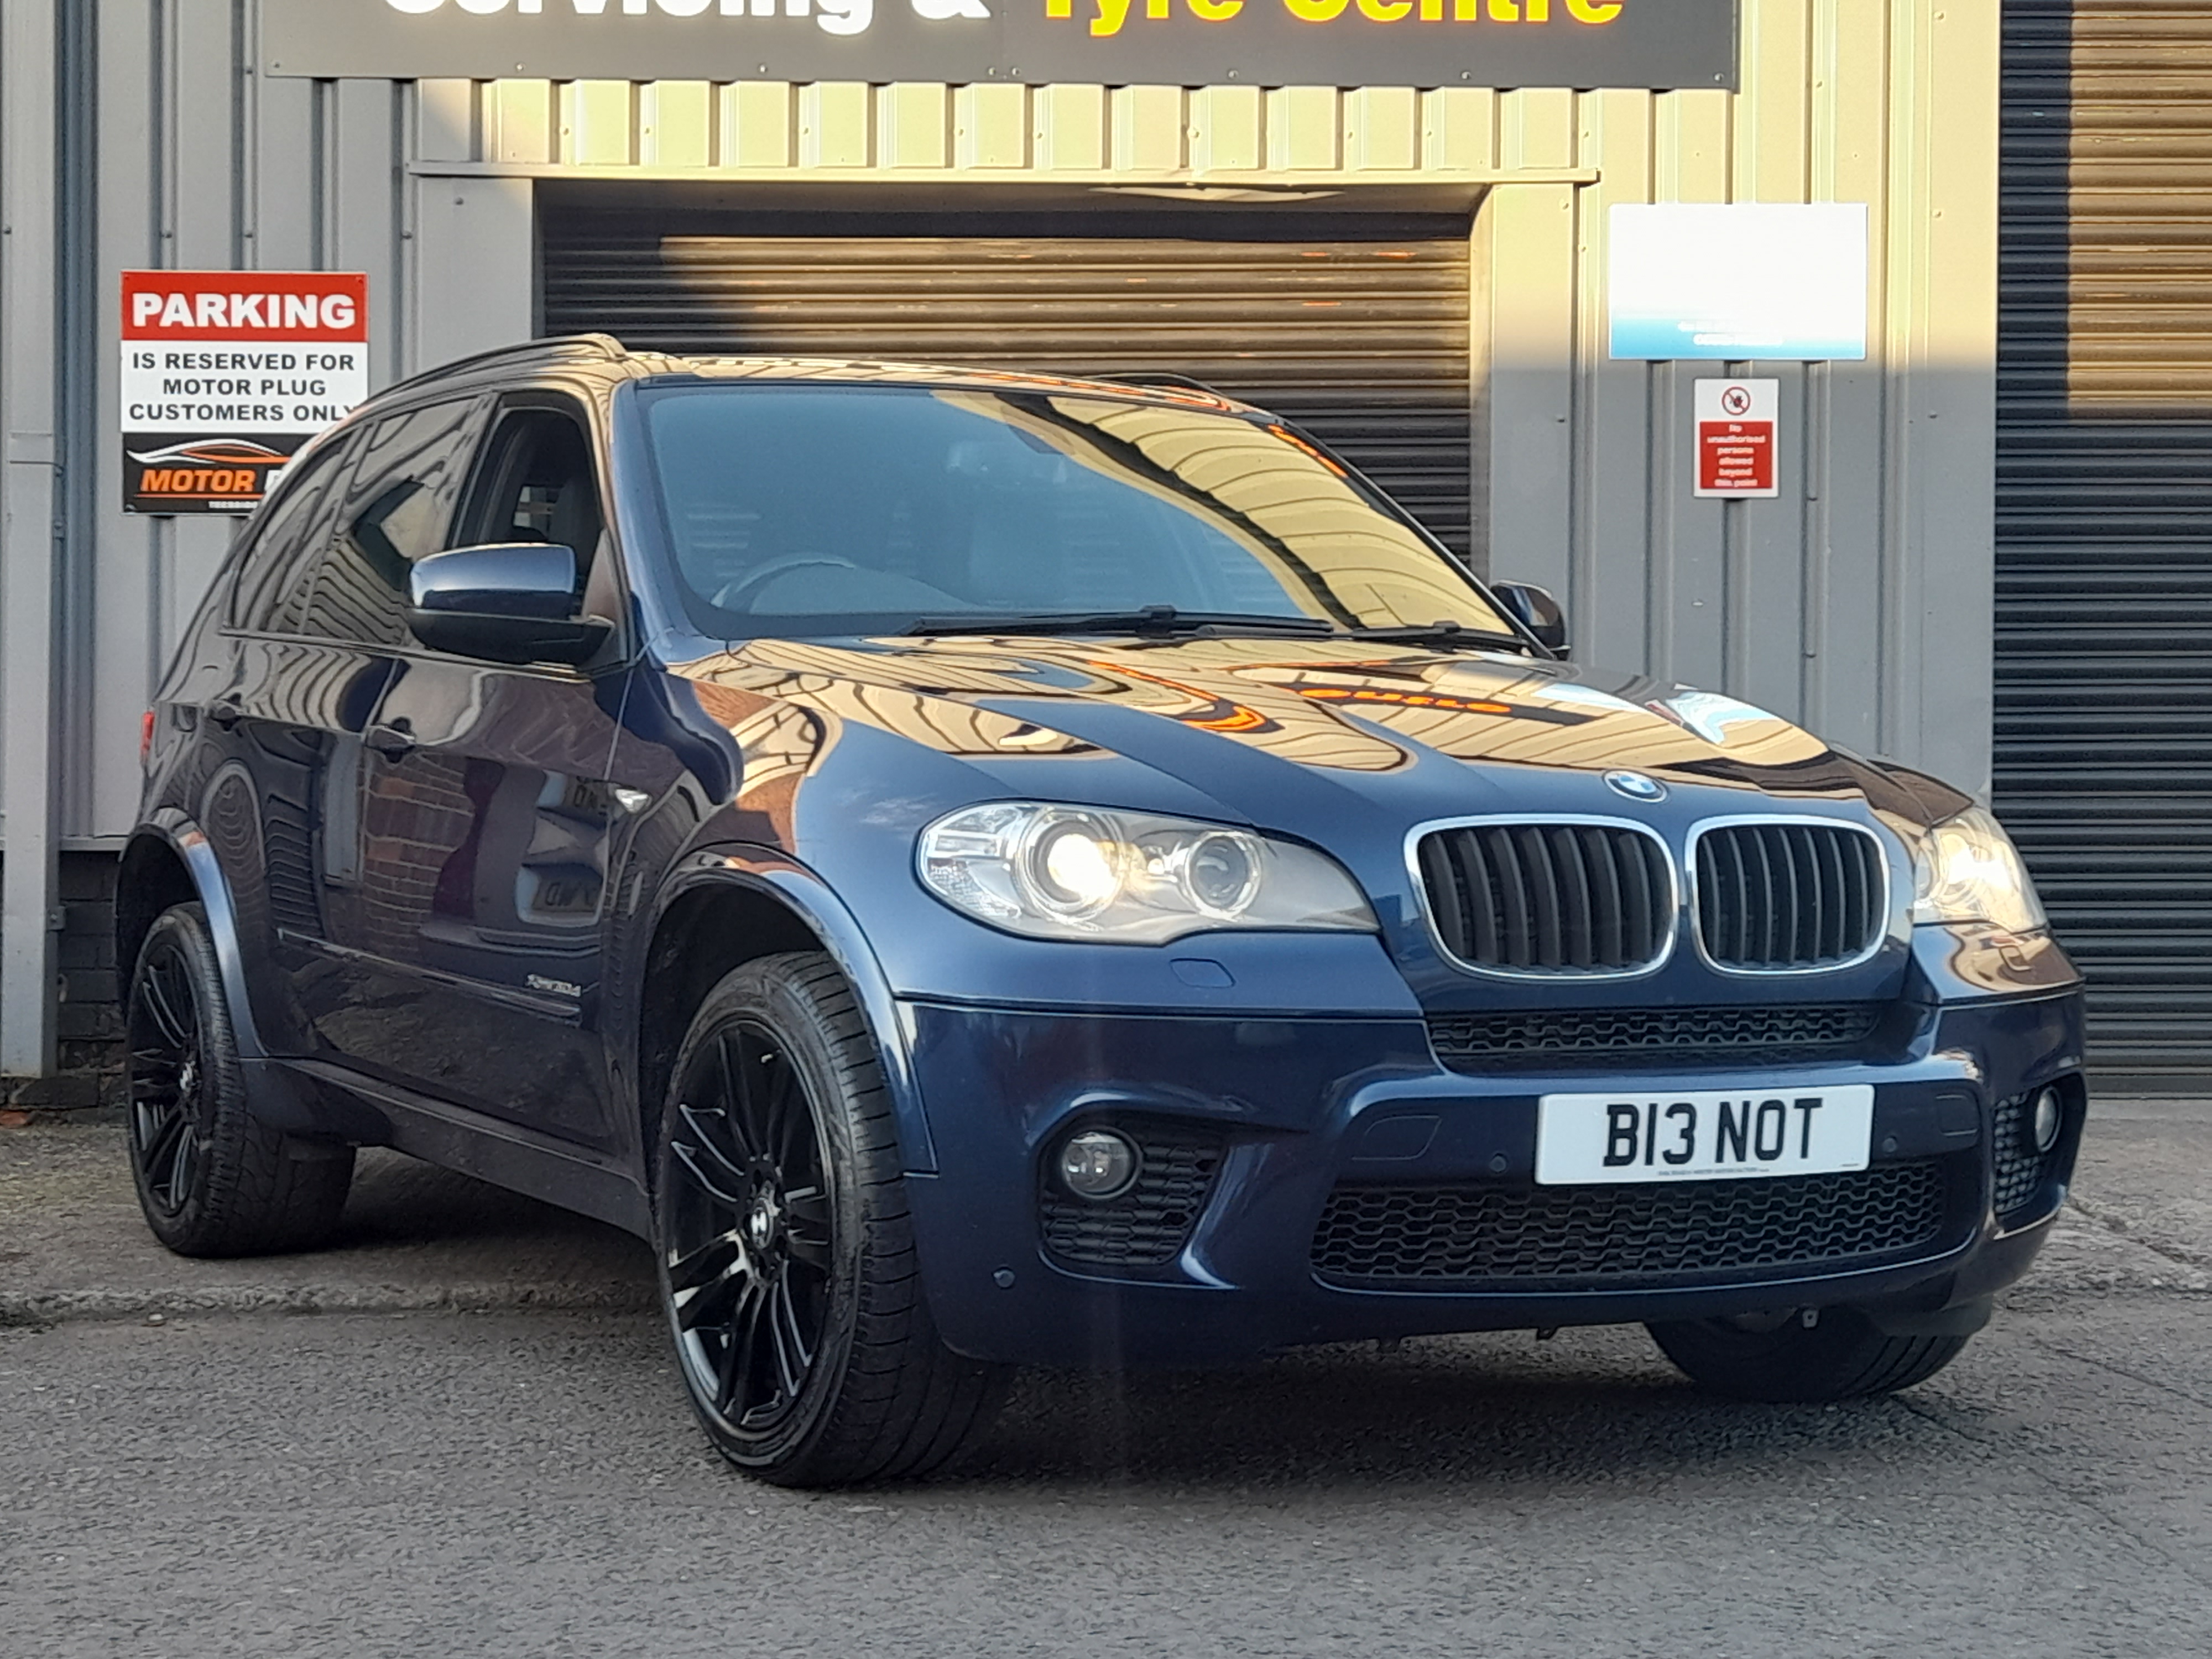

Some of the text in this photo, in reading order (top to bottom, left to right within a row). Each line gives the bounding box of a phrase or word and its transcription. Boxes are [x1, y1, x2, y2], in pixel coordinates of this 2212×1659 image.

[132, 293, 356, 328] PARKING
[133, 353, 355, 371] IS RESERVED FOR
[163, 379, 327, 397] MOTOR PLUG
[129, 404, 284, 422] CUSTOMERS
[140, 469, 256, 492] MOTOR
[1601, 1097, 1823, 1167] B13 NOT
